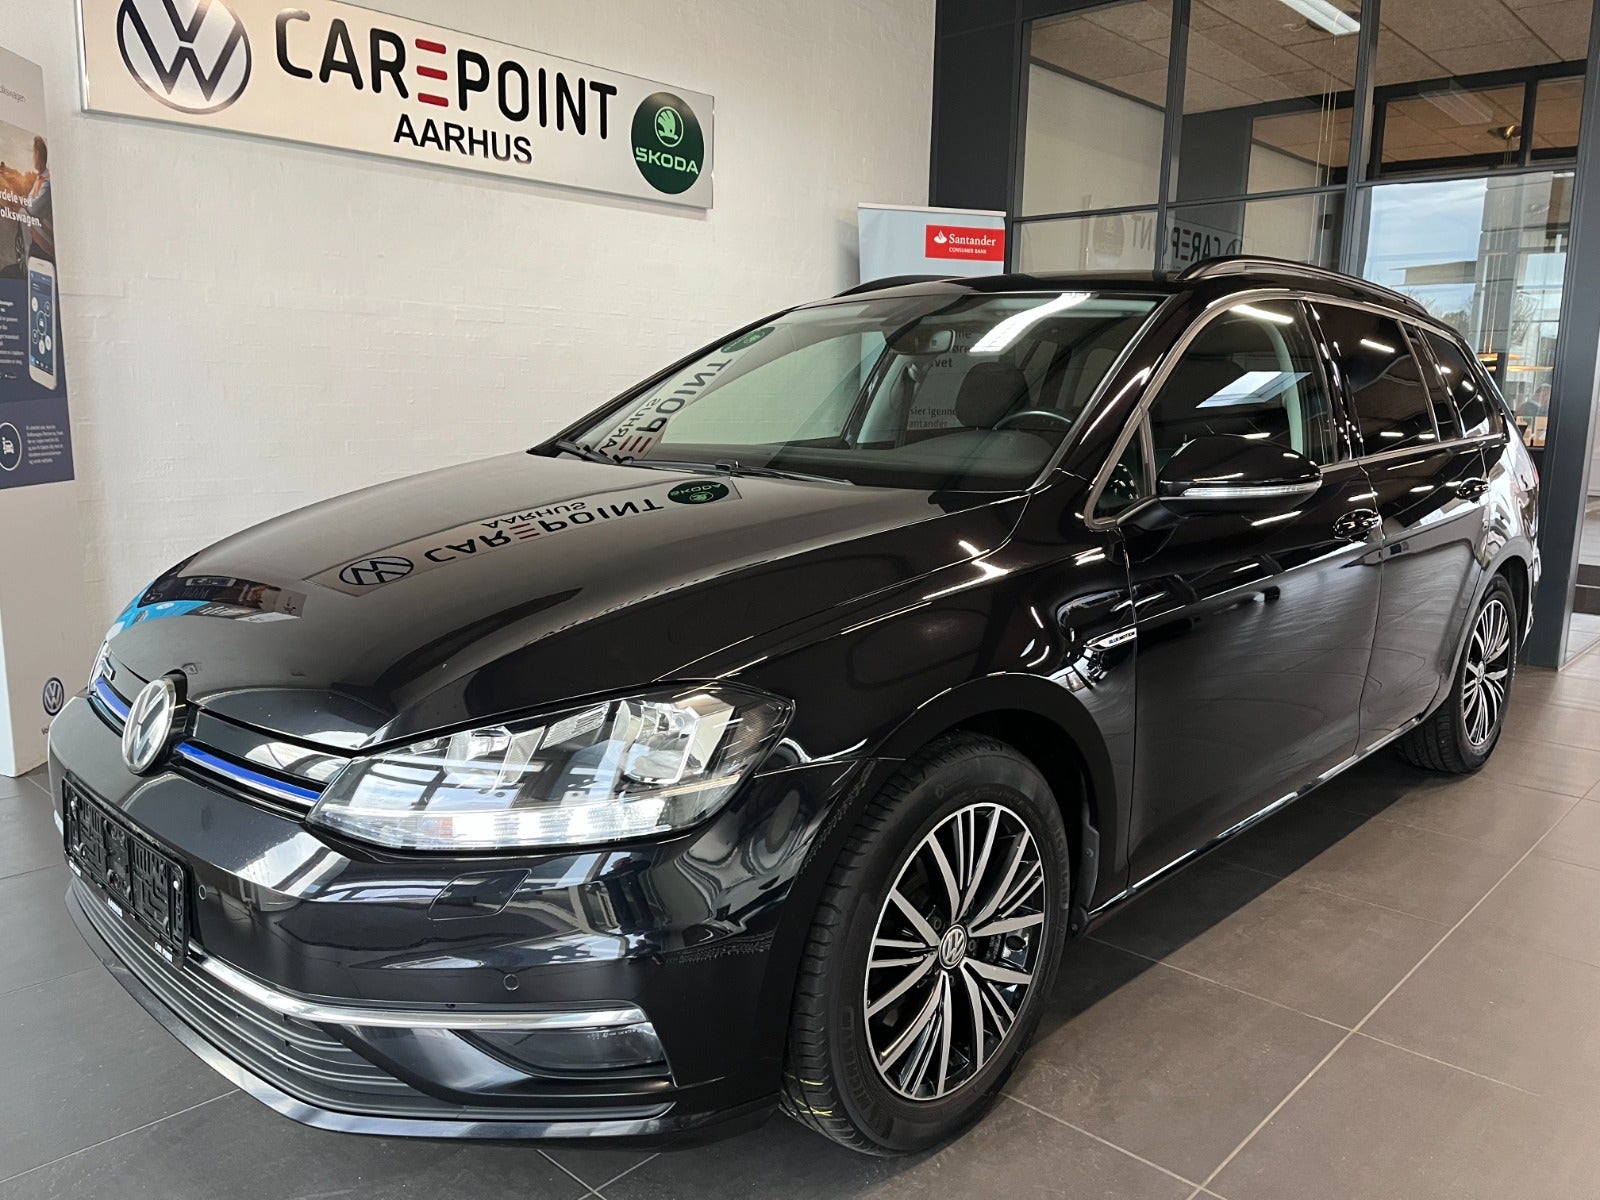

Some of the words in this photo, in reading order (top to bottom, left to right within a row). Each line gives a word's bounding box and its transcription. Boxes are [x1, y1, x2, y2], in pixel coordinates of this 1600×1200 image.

[275, 7, 617, 140] CAREPOINT
[393, 113, 532, 165] AARHUS
[0, 189, 18, 204] rdele
[0, 207, 42, 228] olkswagen.
[948, 233, 997, 247] Santander
[930, 357, 953, 368] vet
[908, 419, 948, 428] antander
